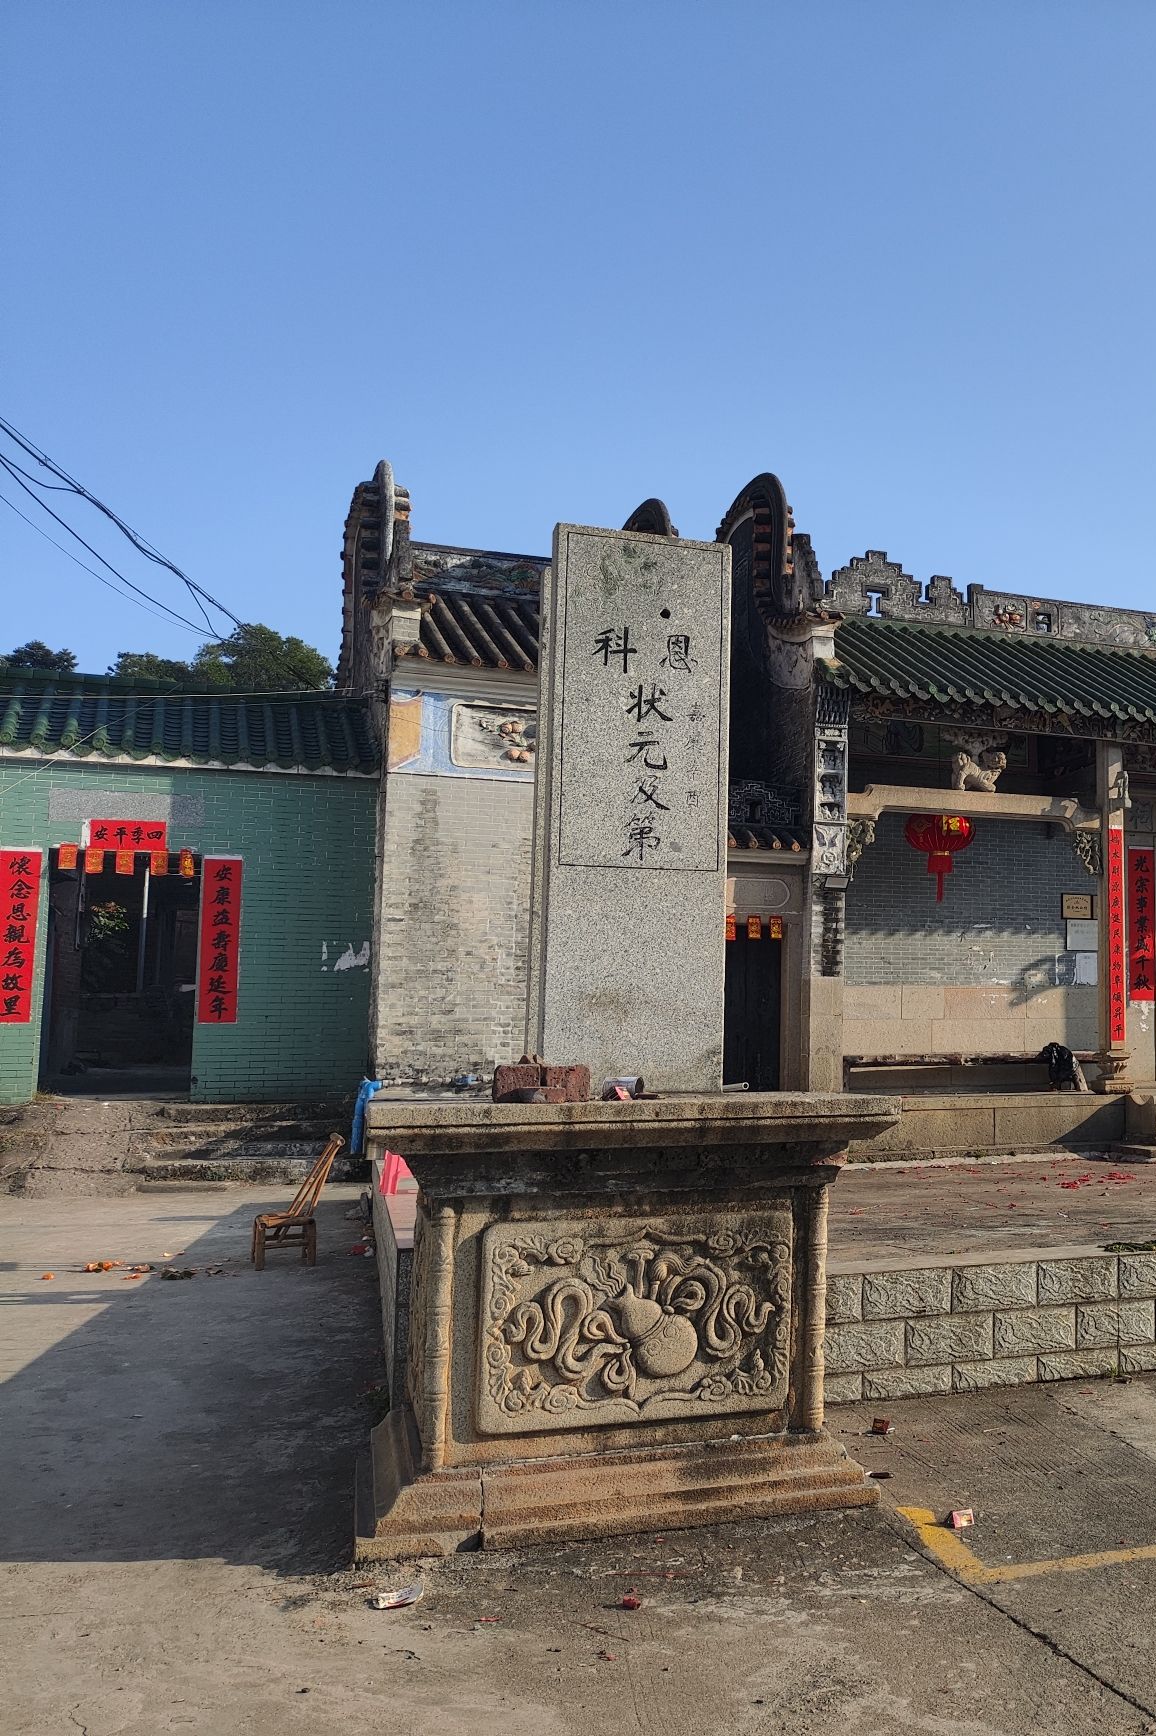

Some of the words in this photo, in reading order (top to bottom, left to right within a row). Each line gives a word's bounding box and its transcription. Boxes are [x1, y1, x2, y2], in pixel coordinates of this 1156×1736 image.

[93, 826, 165, 845] 四季平安
[620, 682, 674, 862] 状元及第
[206, 863, 234, 1021] 安康益壽慶延年
[1133, 855, 1153, 991] 光宗事業盛千秋
